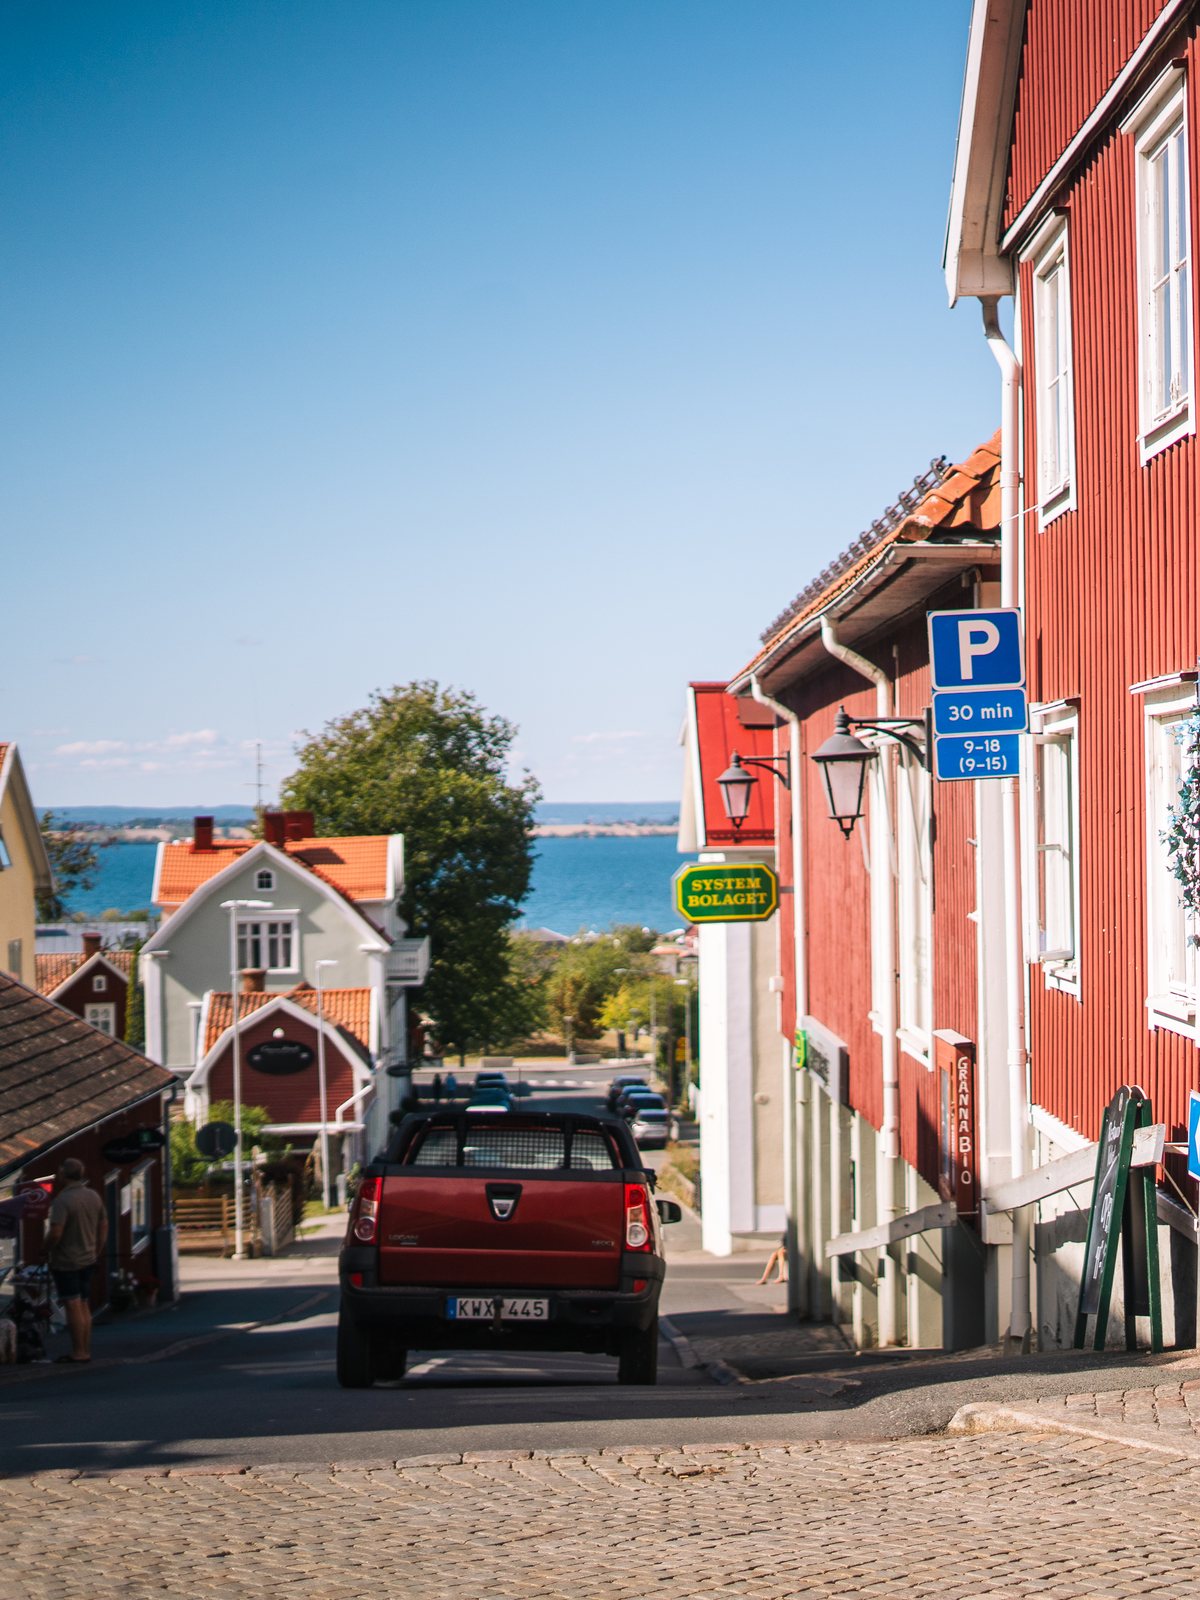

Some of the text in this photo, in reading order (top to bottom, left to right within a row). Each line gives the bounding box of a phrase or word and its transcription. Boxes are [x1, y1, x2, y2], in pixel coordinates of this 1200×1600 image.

[957, 620, 1000, 680] P
[948, 703, 1013, 721] 30 min
[963, 739, 1000, 754] 9-18
[959, 755, 1007, 773] (9-15)
[691, 877, 762, 892] SYSTEM
[687, 892, 767, 907] BOLAGET
[458, 1300, 544, 1317] KWX 445
